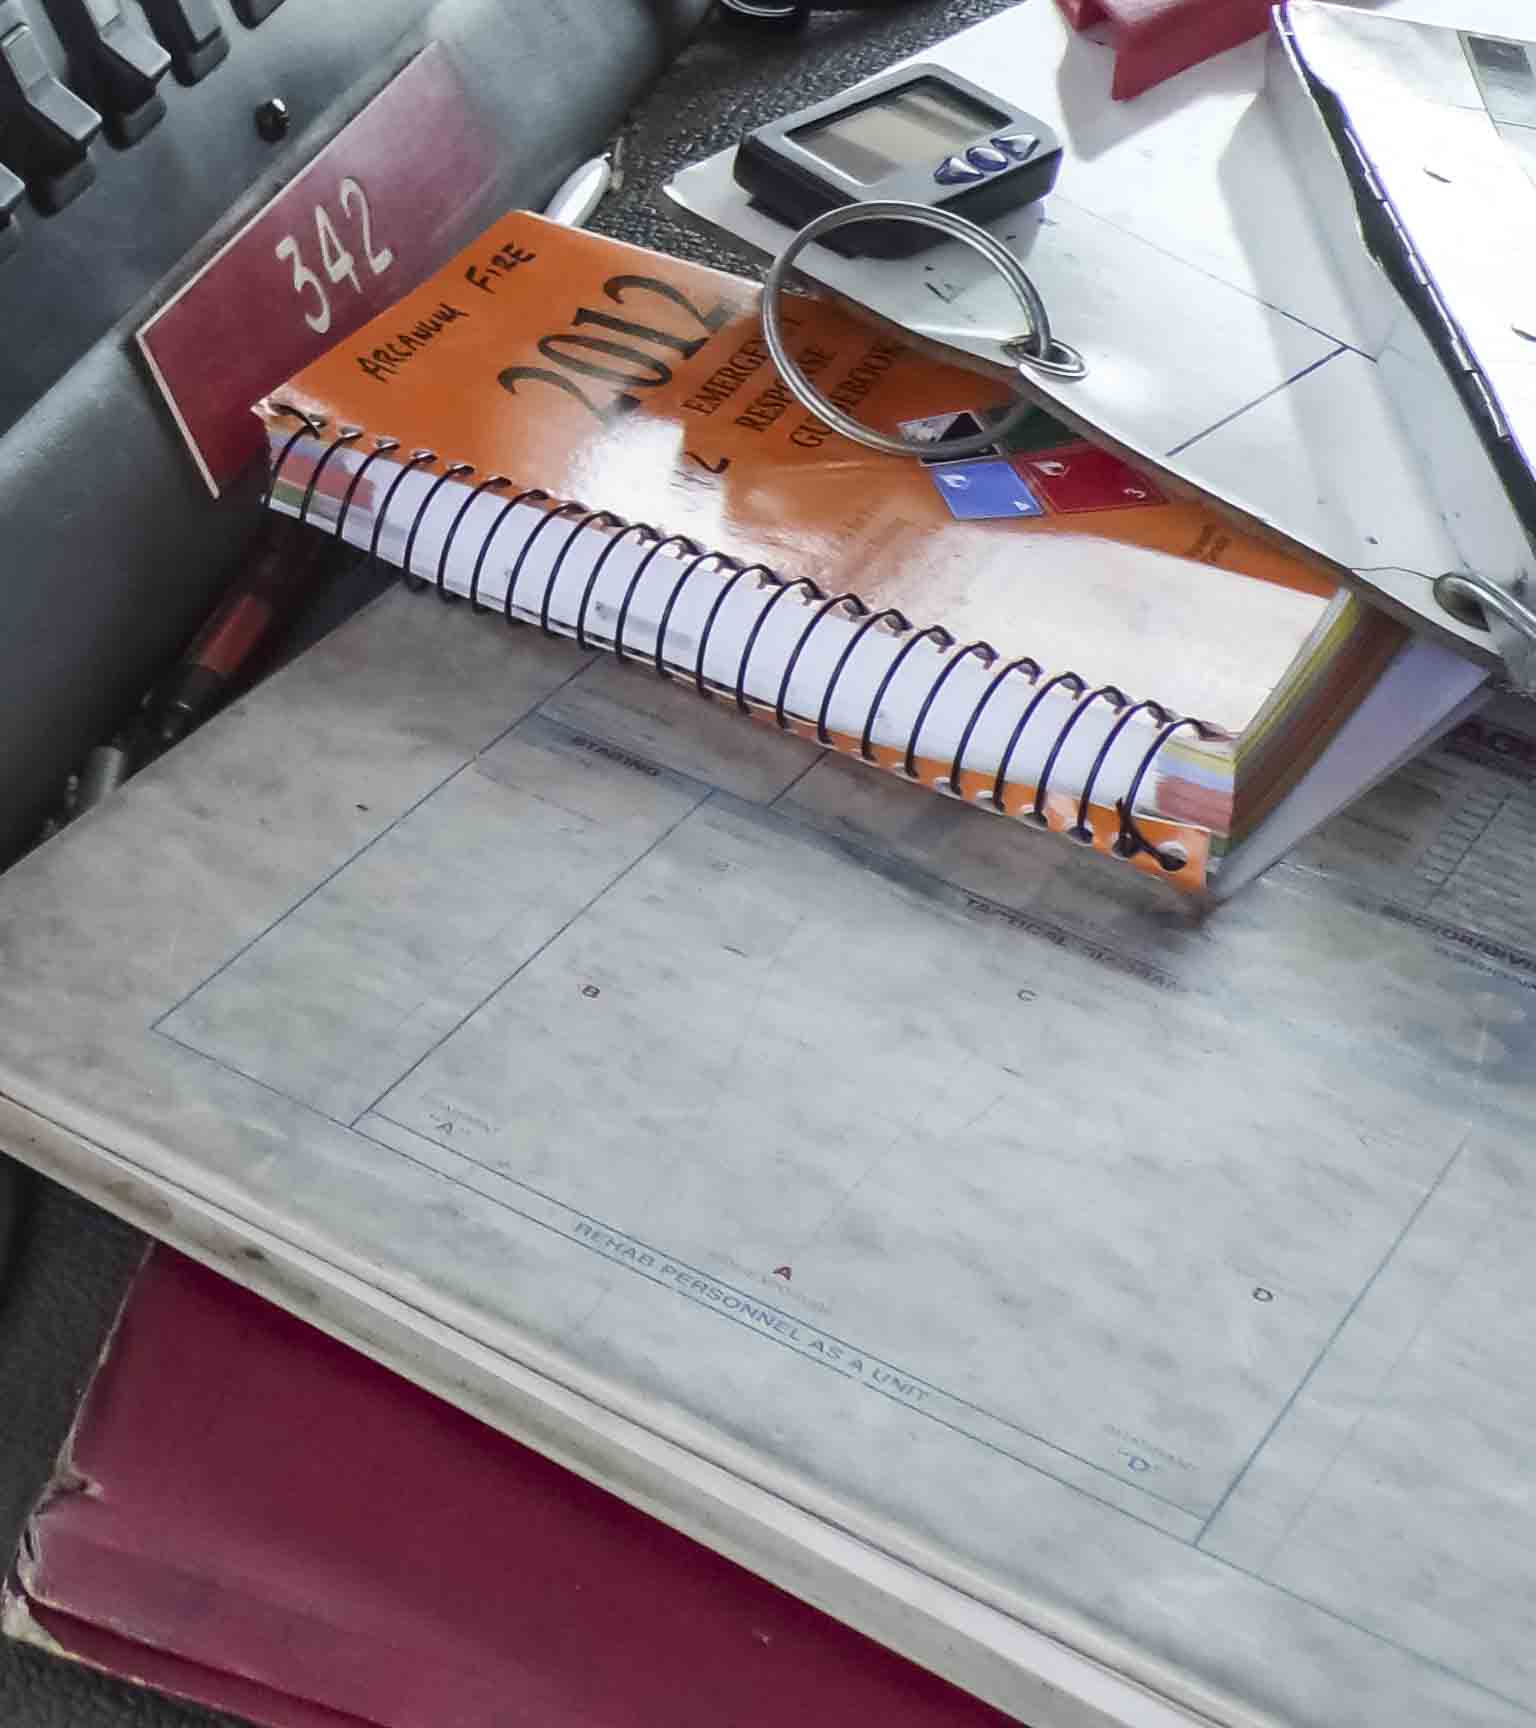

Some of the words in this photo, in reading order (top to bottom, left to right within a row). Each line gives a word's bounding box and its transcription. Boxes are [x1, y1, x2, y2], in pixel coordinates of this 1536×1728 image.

[275, 175, 393, 335] 342
[466, 239, 537, 294] FIRE
[497, 274, 736, 435] 2012
[680, 315, 800, 415] EMERGE
[660, 1263, 801, 1342] PERSONNEL
[807, 1338, 845, 1361] AS
[871, 1367, 931, 1402] UNIT
